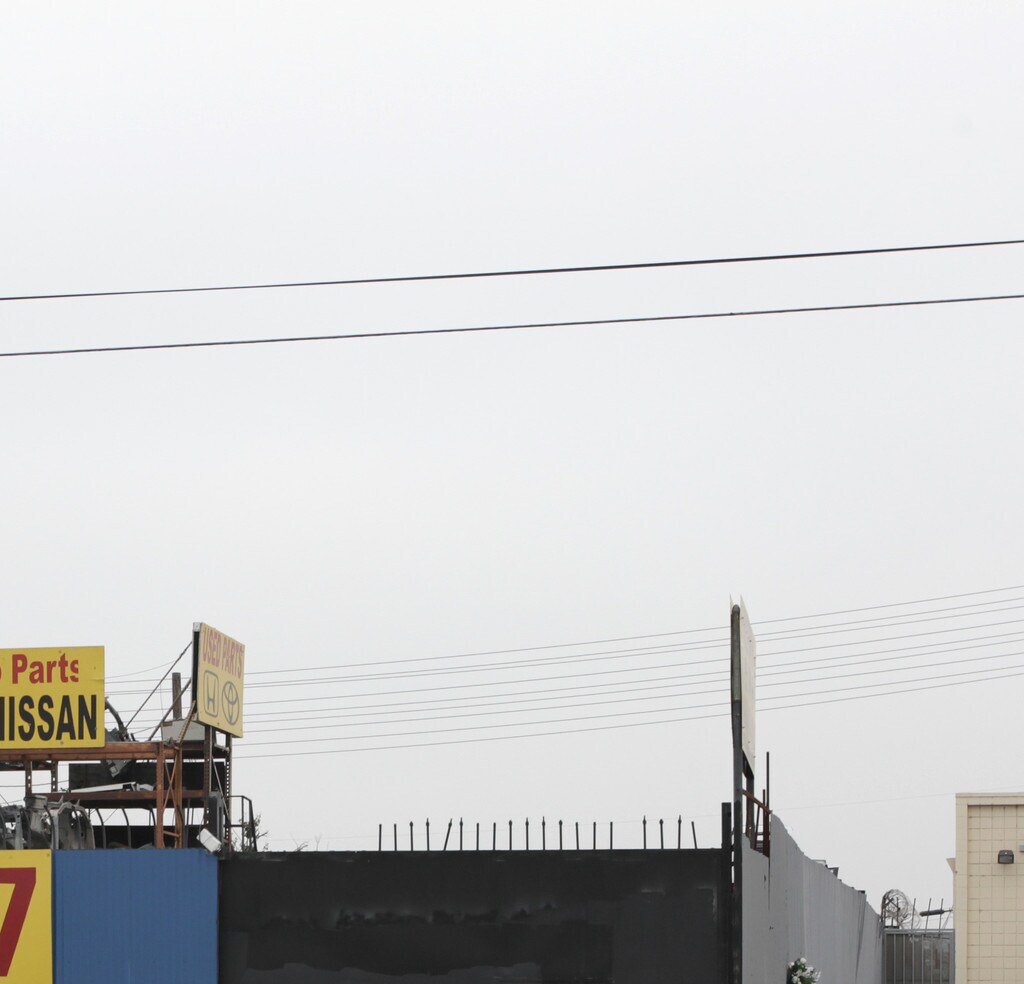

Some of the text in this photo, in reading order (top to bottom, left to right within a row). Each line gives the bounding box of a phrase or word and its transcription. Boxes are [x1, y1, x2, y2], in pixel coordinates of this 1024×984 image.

[12, 653, 79, 684] Parts
[203, 627, 244, 679] USED PARTS
